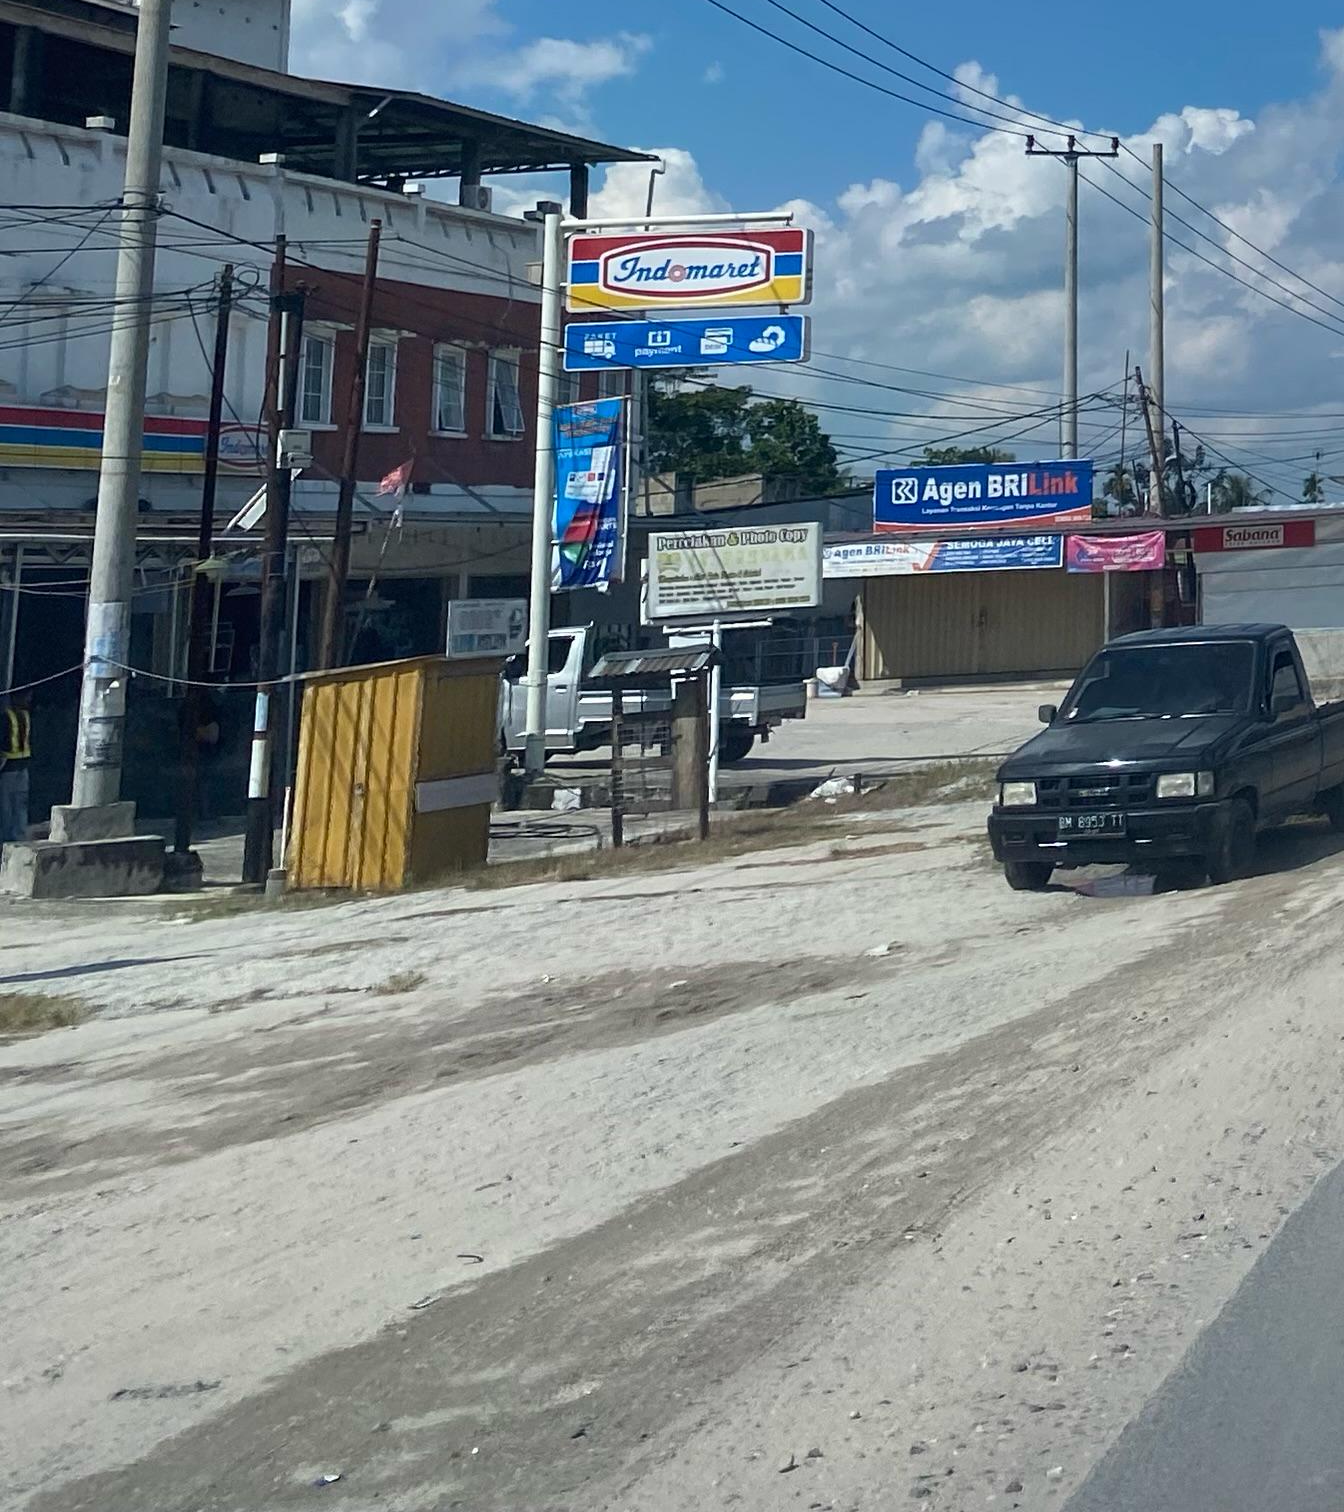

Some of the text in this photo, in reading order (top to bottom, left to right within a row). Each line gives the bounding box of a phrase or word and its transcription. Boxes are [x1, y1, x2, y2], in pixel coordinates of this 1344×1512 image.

[613, 254, 761, 283] Indomaret
[922, 471, 1079, 505] Agen BRILink
[740, 529, 777, 546] Photo
[778, 527, 809, 543] Copy
[1225, 528, 1280, 543] Sabana
[834, 548, 862, 560] Agen
